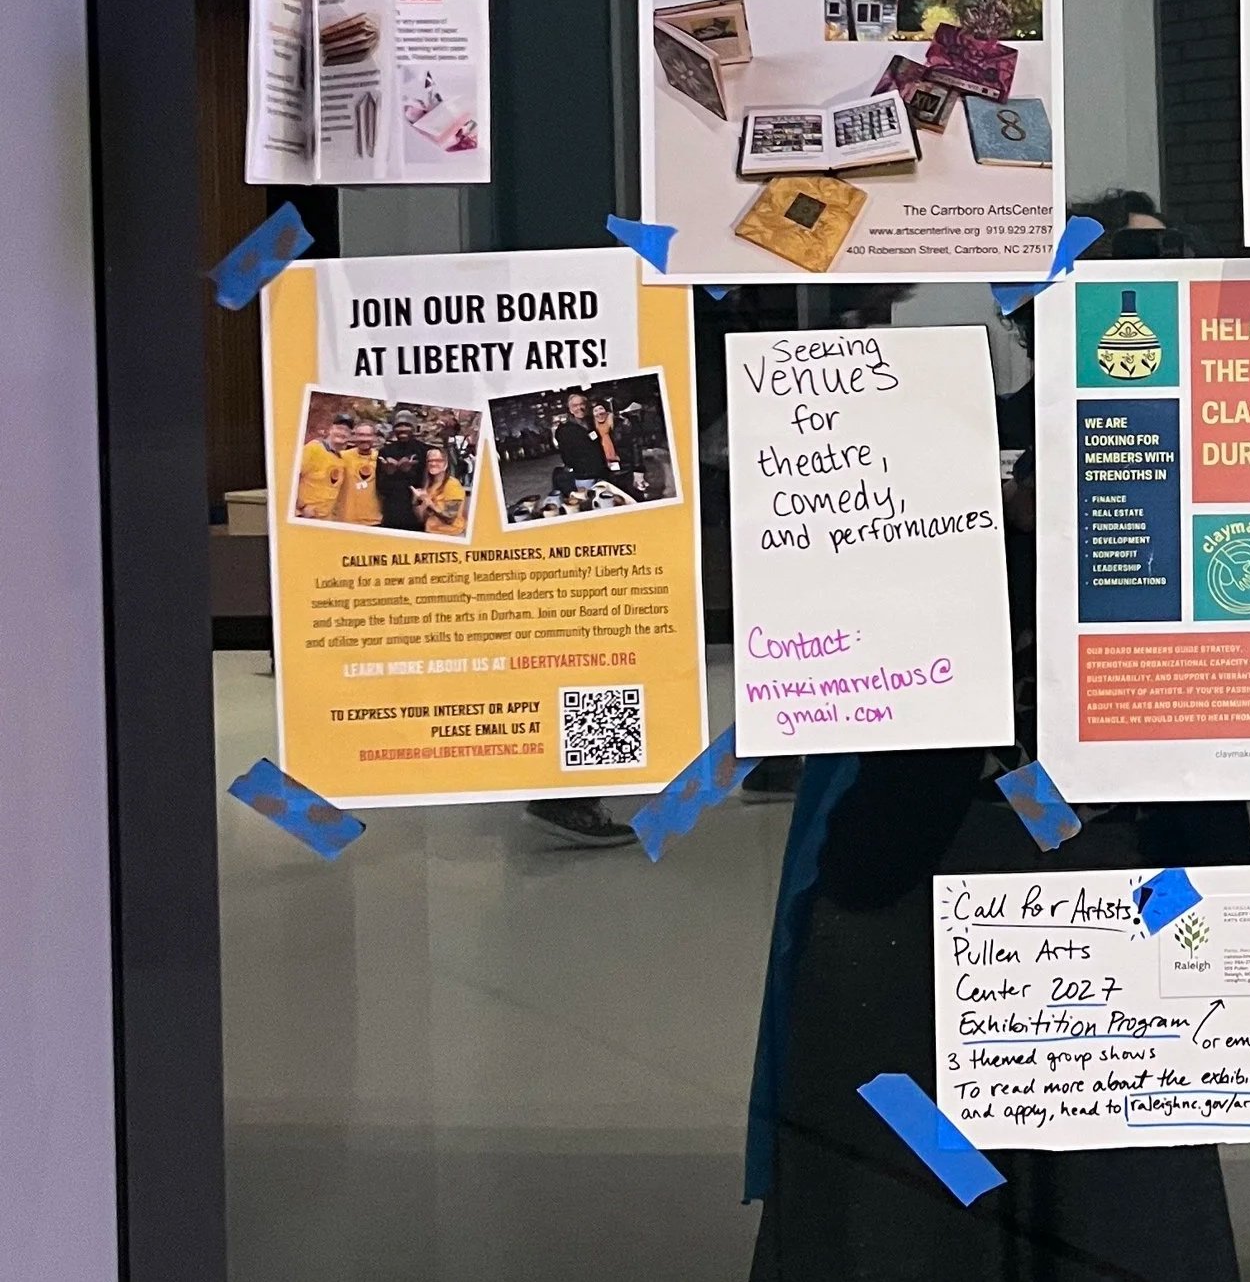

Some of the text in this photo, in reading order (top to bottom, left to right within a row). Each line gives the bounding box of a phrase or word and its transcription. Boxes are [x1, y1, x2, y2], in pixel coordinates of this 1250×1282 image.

[997, 110, 1026, 141] 8
[904, 204, 1053, 215] The Carrboro ArtsCenter
[350, 291, 597, 328] JOIN OUR BOARD
[355, 339, 607, 376] AT LIBERTY ARTS!
[773, 336, 883, 371] Seeking
[744, 356, 898, 395] Venues
[1201, 360, 1250, 382] THE
[791, 404, 839, 434] for
[1085, 418, 1127, 428] WE ARE
[1085, 435, 1159, 446] LOOKING FOR
[758, 444, 887, 476] theatre,
[774, 479, 904, 517] comedy,
[762, 509, 997, 553] and performances.
[343, 544, 635, 567] CALLING ALL ARTISTS, FUNDRAISERS, AND CREATIVES!
[1093, 577, 1166, 585] COMMUNICATIONS
[749, 626, 860, 660] Contact:
[747, 658, 953, 703] mikkimarvelous@
[331, 702, 539, 721] TO EXPRESS YOUR INTEREST OR APPLY
[777, 702, 892, 735] gmail.com
[954, 892, 1006, 920] Call
[1021, 885, 1069, 919] for
[953, 937, 1090, 966] Pullen Arts
[1175, 961, 1210, 972] Raleigh
[956, 973, 1122, 1002] Center 2027
[1107, 1011, 1190, 1038] Program
